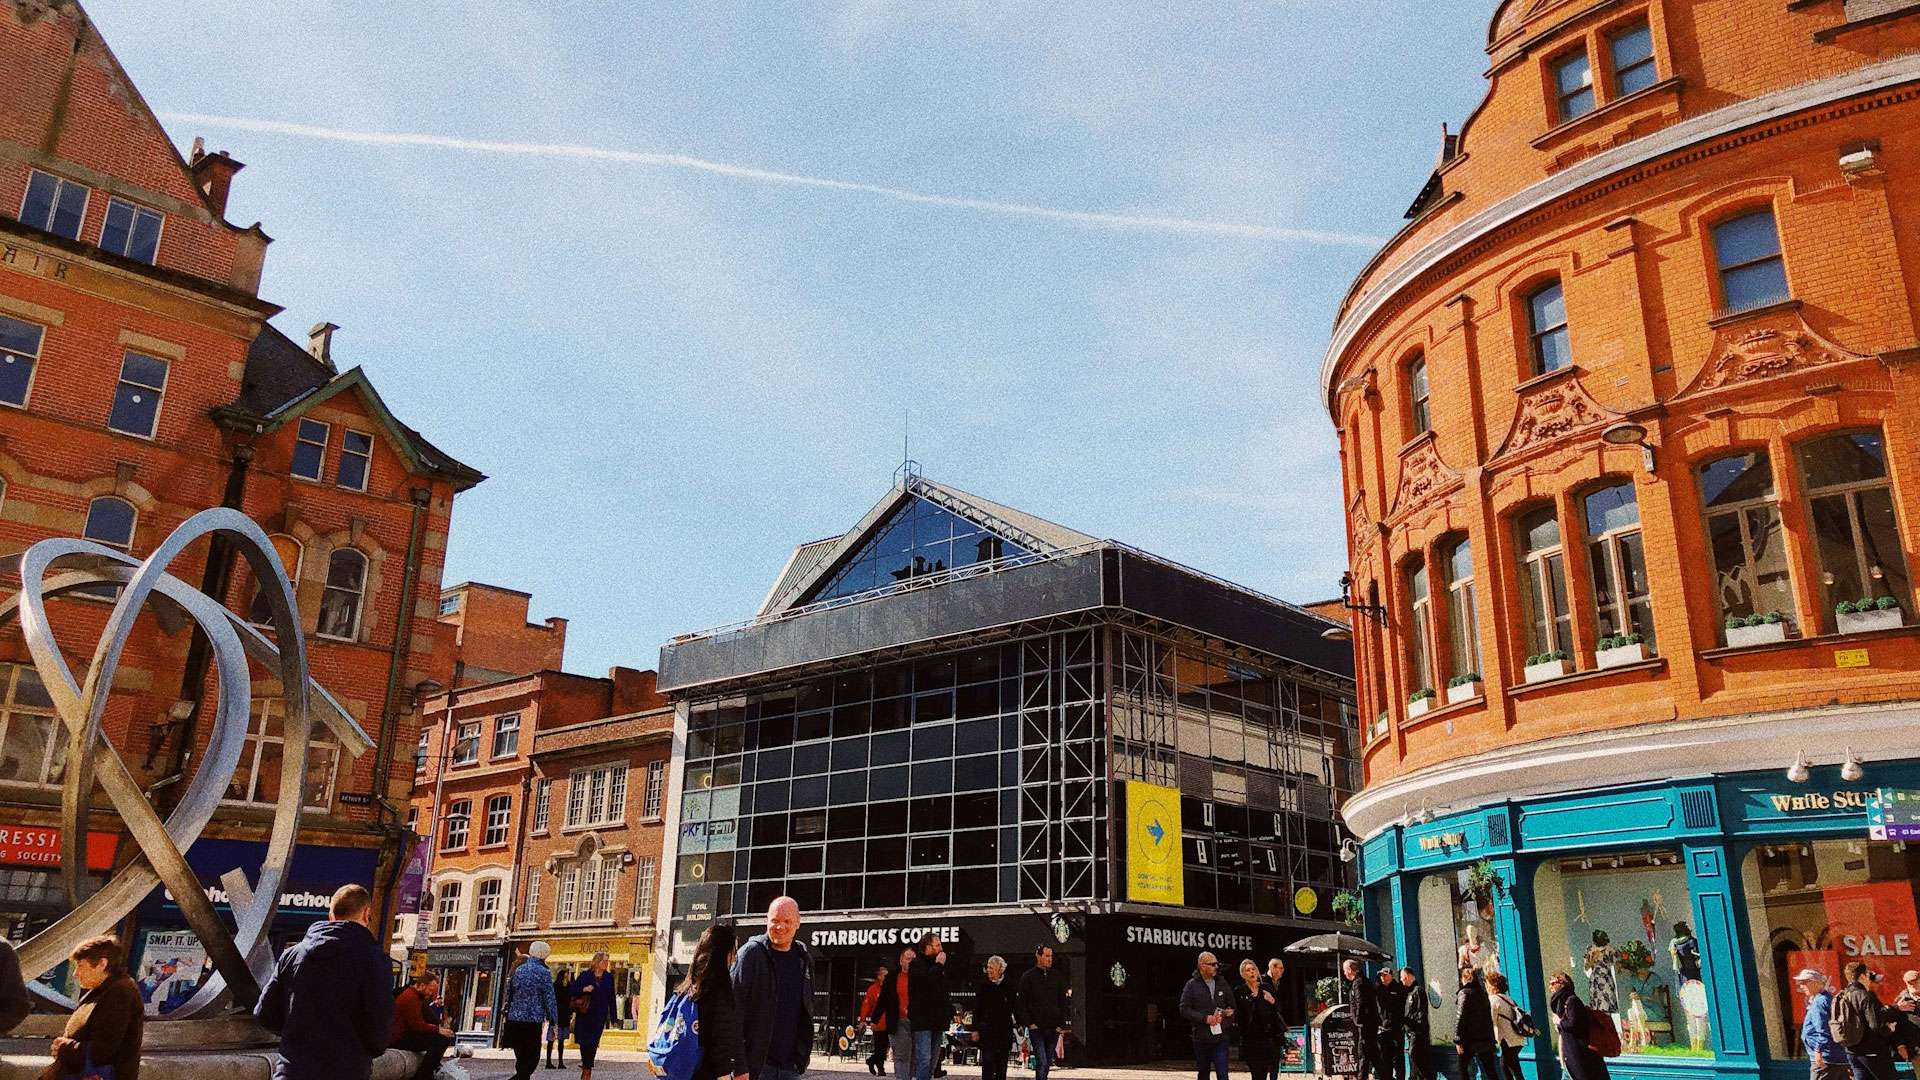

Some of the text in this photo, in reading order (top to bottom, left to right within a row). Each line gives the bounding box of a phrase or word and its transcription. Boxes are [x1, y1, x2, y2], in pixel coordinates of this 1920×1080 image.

[0, 829, 57, 848] RESSI
[16, 850, 62, 862] SOCIETY
[149, 934, 172, 946] SNAP.
[811, 928, 898, 946] STARBUCKS
[1126, 925, 1253, 951] STARBUCKS COFFEE
[1843, 933, 1911, 956] SALE
